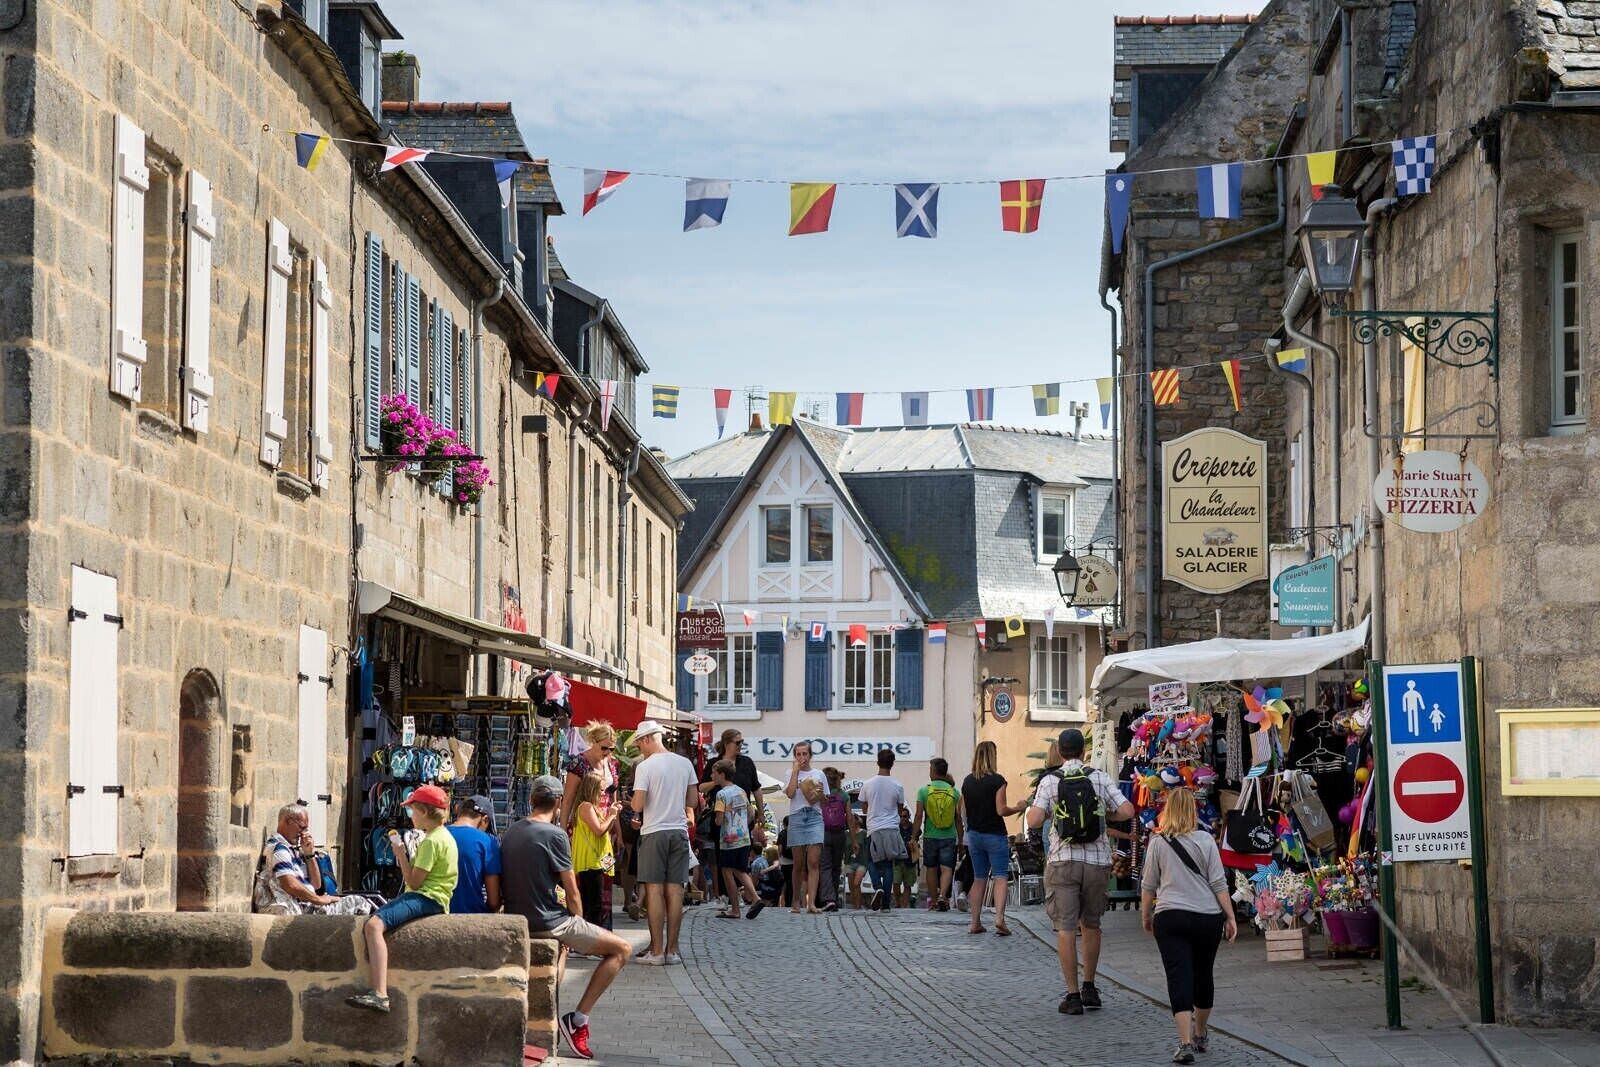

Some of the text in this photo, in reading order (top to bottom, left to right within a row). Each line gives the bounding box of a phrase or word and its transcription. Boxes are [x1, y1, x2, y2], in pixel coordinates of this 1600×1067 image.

[1172, 447, 1257, 485] Crêperie
[1392, 469, 1473, 481] Marie Stuart
[1208, 488, 1223, 504] la
[1385, 487, 1479, 498] RESTAURANT
[1181, 498, 1256, 520] Chandeleur
[1386, 499, 1477, 515] PIZZERIA
[1176, 547, 1258, 558] SALADERIE
[1183, 561, 1248, 573] GLACIER
[1283, 583, 1329, 593] Cadeaux
[1283, 601, 1329, 611] Souvenirs
[1394, 830, 1469, 841] SAUF LIVRAISONS
[1397, 840, 1466, 853] ET SÉCURITÉ
